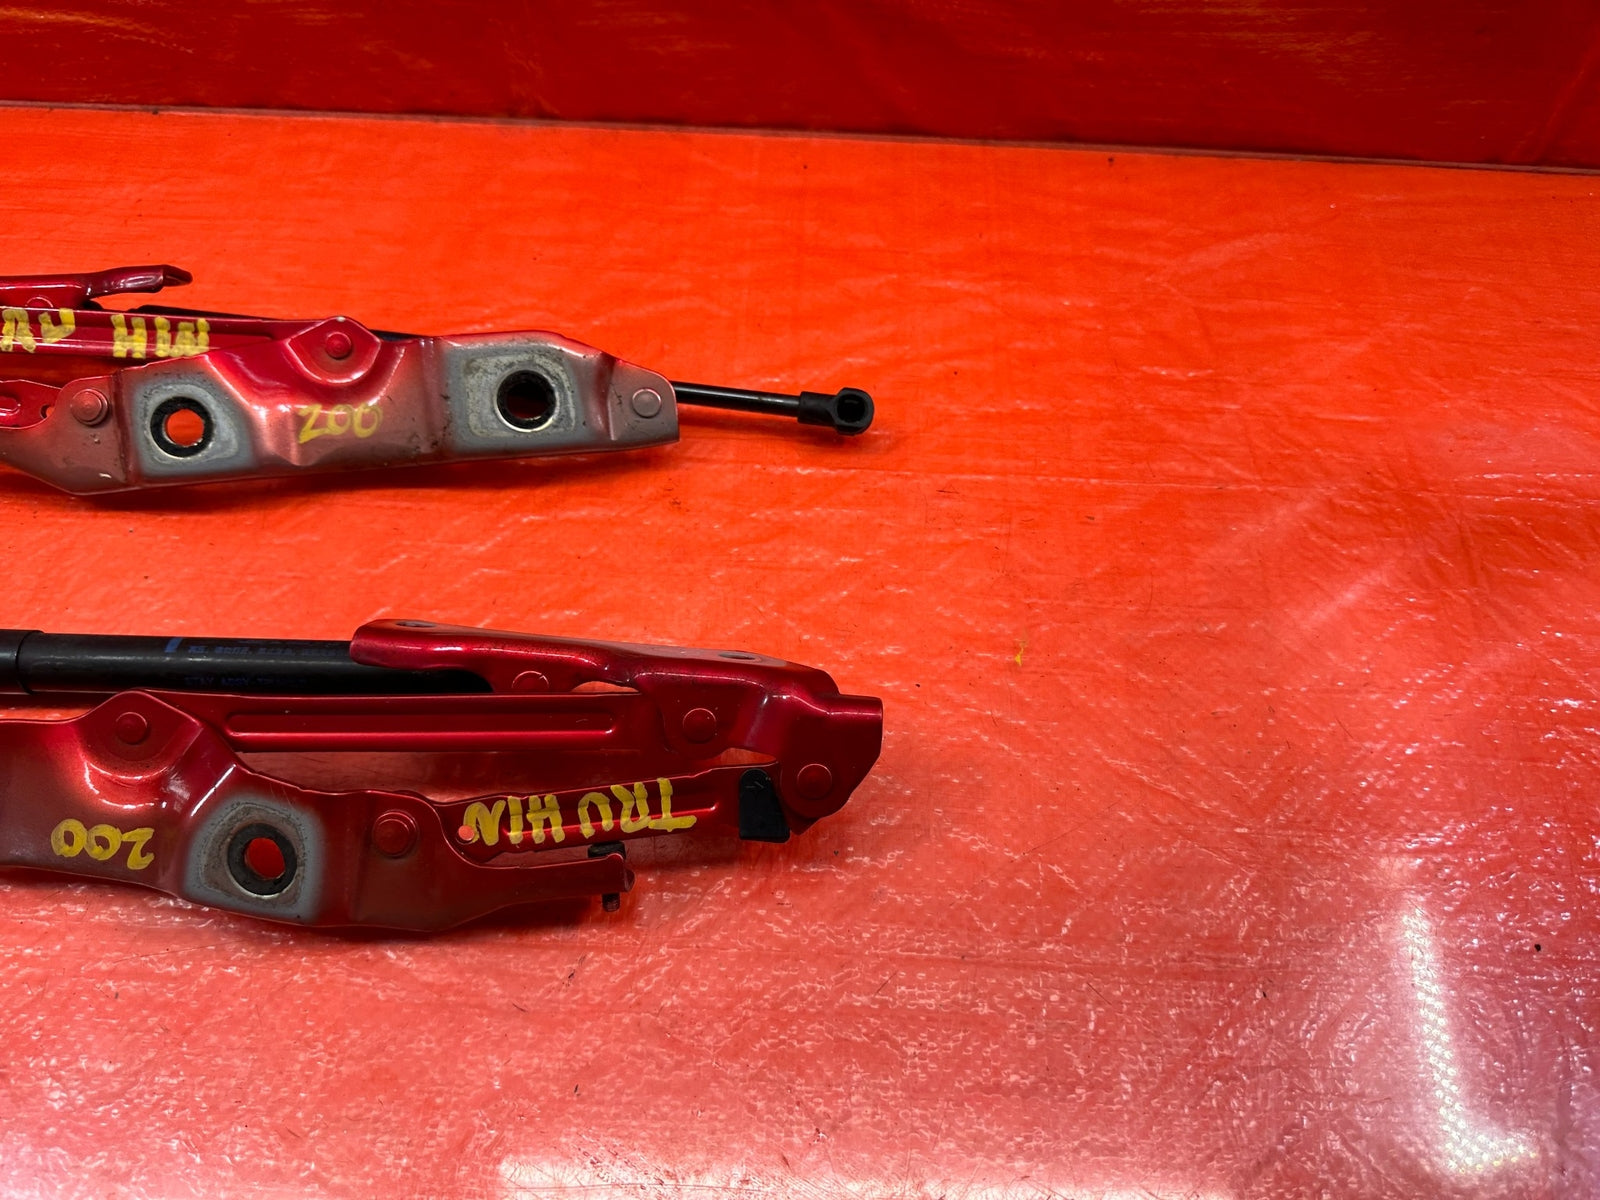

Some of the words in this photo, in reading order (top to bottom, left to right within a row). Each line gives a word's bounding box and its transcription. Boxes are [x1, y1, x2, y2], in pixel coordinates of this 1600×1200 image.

[298, 403, 383, 444] 200
[463, 795, 566, 846] HIN
[578, 778, 697, 839] TRU
[51, 819, 154, 870] 200
